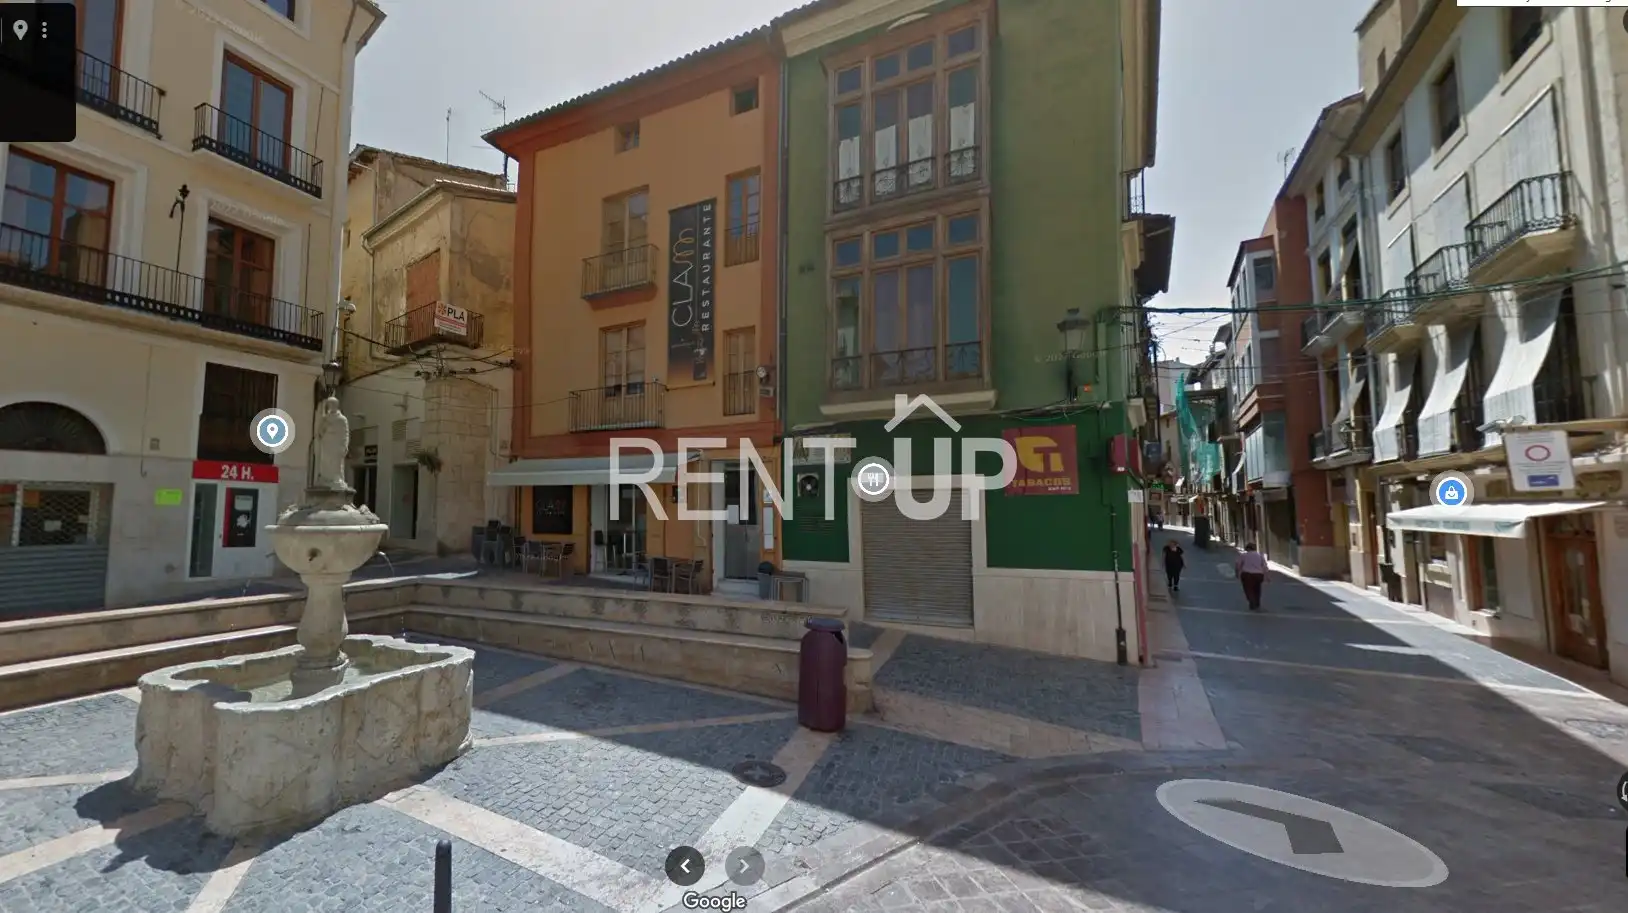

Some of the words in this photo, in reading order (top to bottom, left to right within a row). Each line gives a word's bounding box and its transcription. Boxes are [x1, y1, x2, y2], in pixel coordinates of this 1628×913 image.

[701, 203, 712, 332] RESTAURANTE
[447, 307, 465, 322] PLA
[221, 465, 239, 480] 24
